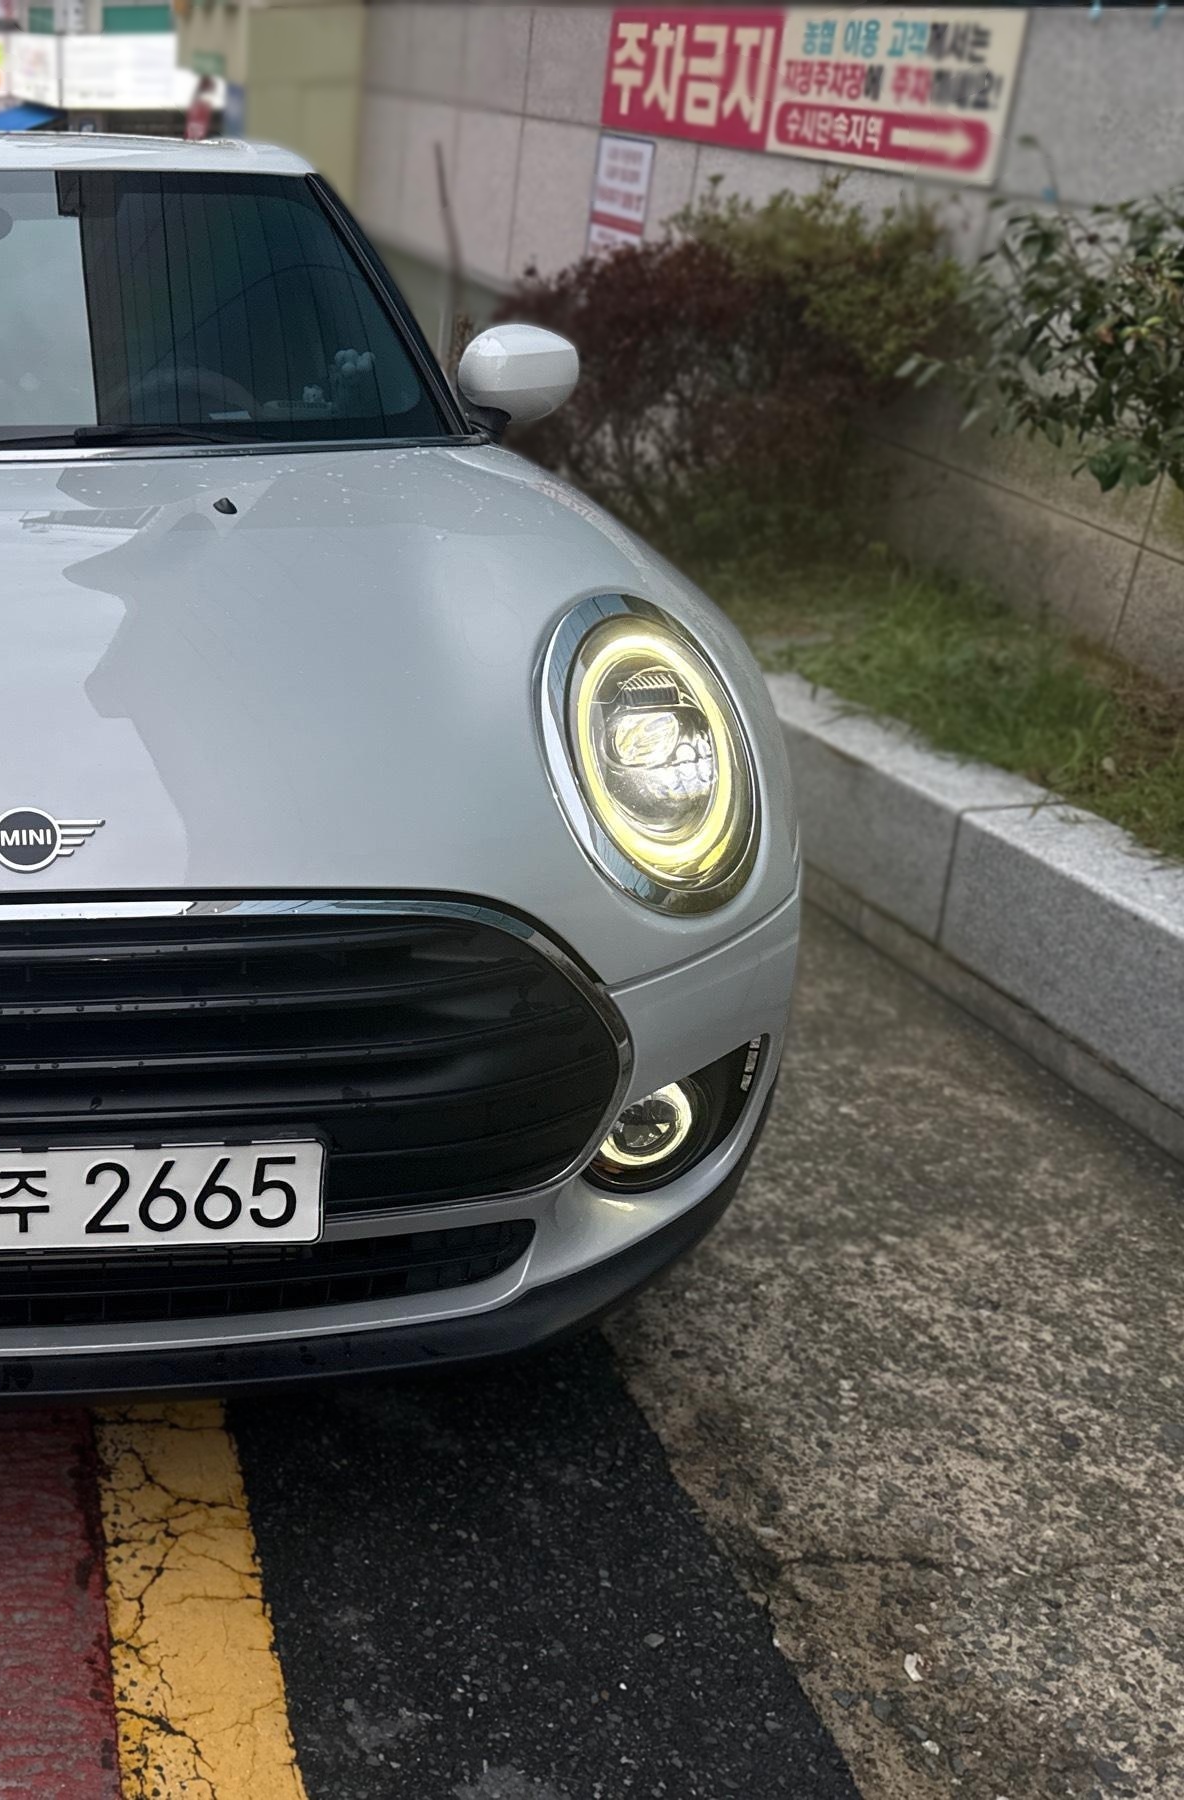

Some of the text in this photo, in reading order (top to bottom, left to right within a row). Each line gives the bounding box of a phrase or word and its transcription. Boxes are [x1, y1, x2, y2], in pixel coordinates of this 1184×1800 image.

[802, 20, 837, 55] 농협
[843, 19, 881, 58] 이용
[612, 22, 776, 134] 주차금지
[786, 109, 884, 152] 수시단속지역
[0, 828, 52, 847] MINI
[84, 1156, 297, 1234] 2665
